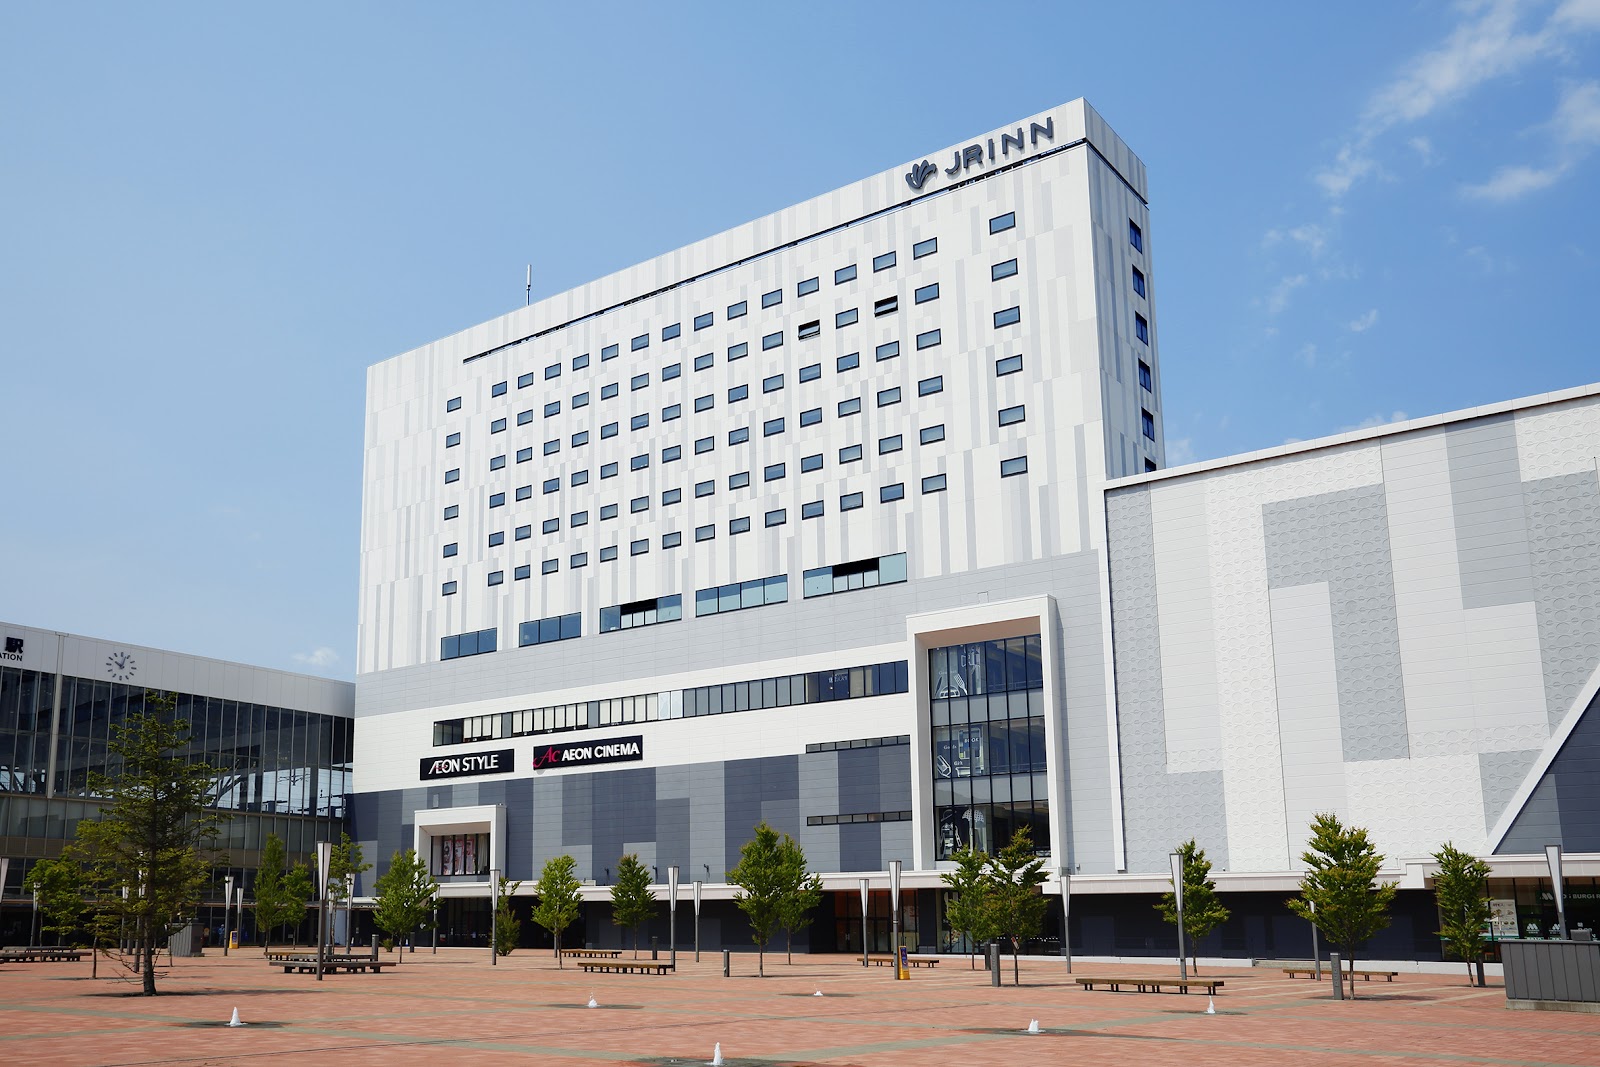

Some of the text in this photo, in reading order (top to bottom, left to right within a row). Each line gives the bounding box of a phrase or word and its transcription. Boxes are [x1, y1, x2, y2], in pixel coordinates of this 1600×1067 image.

[944, 116, 1054, 175] JRINN
[561, 742, 640, 762] AEON CINEMA
[462, 754, 499, 772] STYLE
